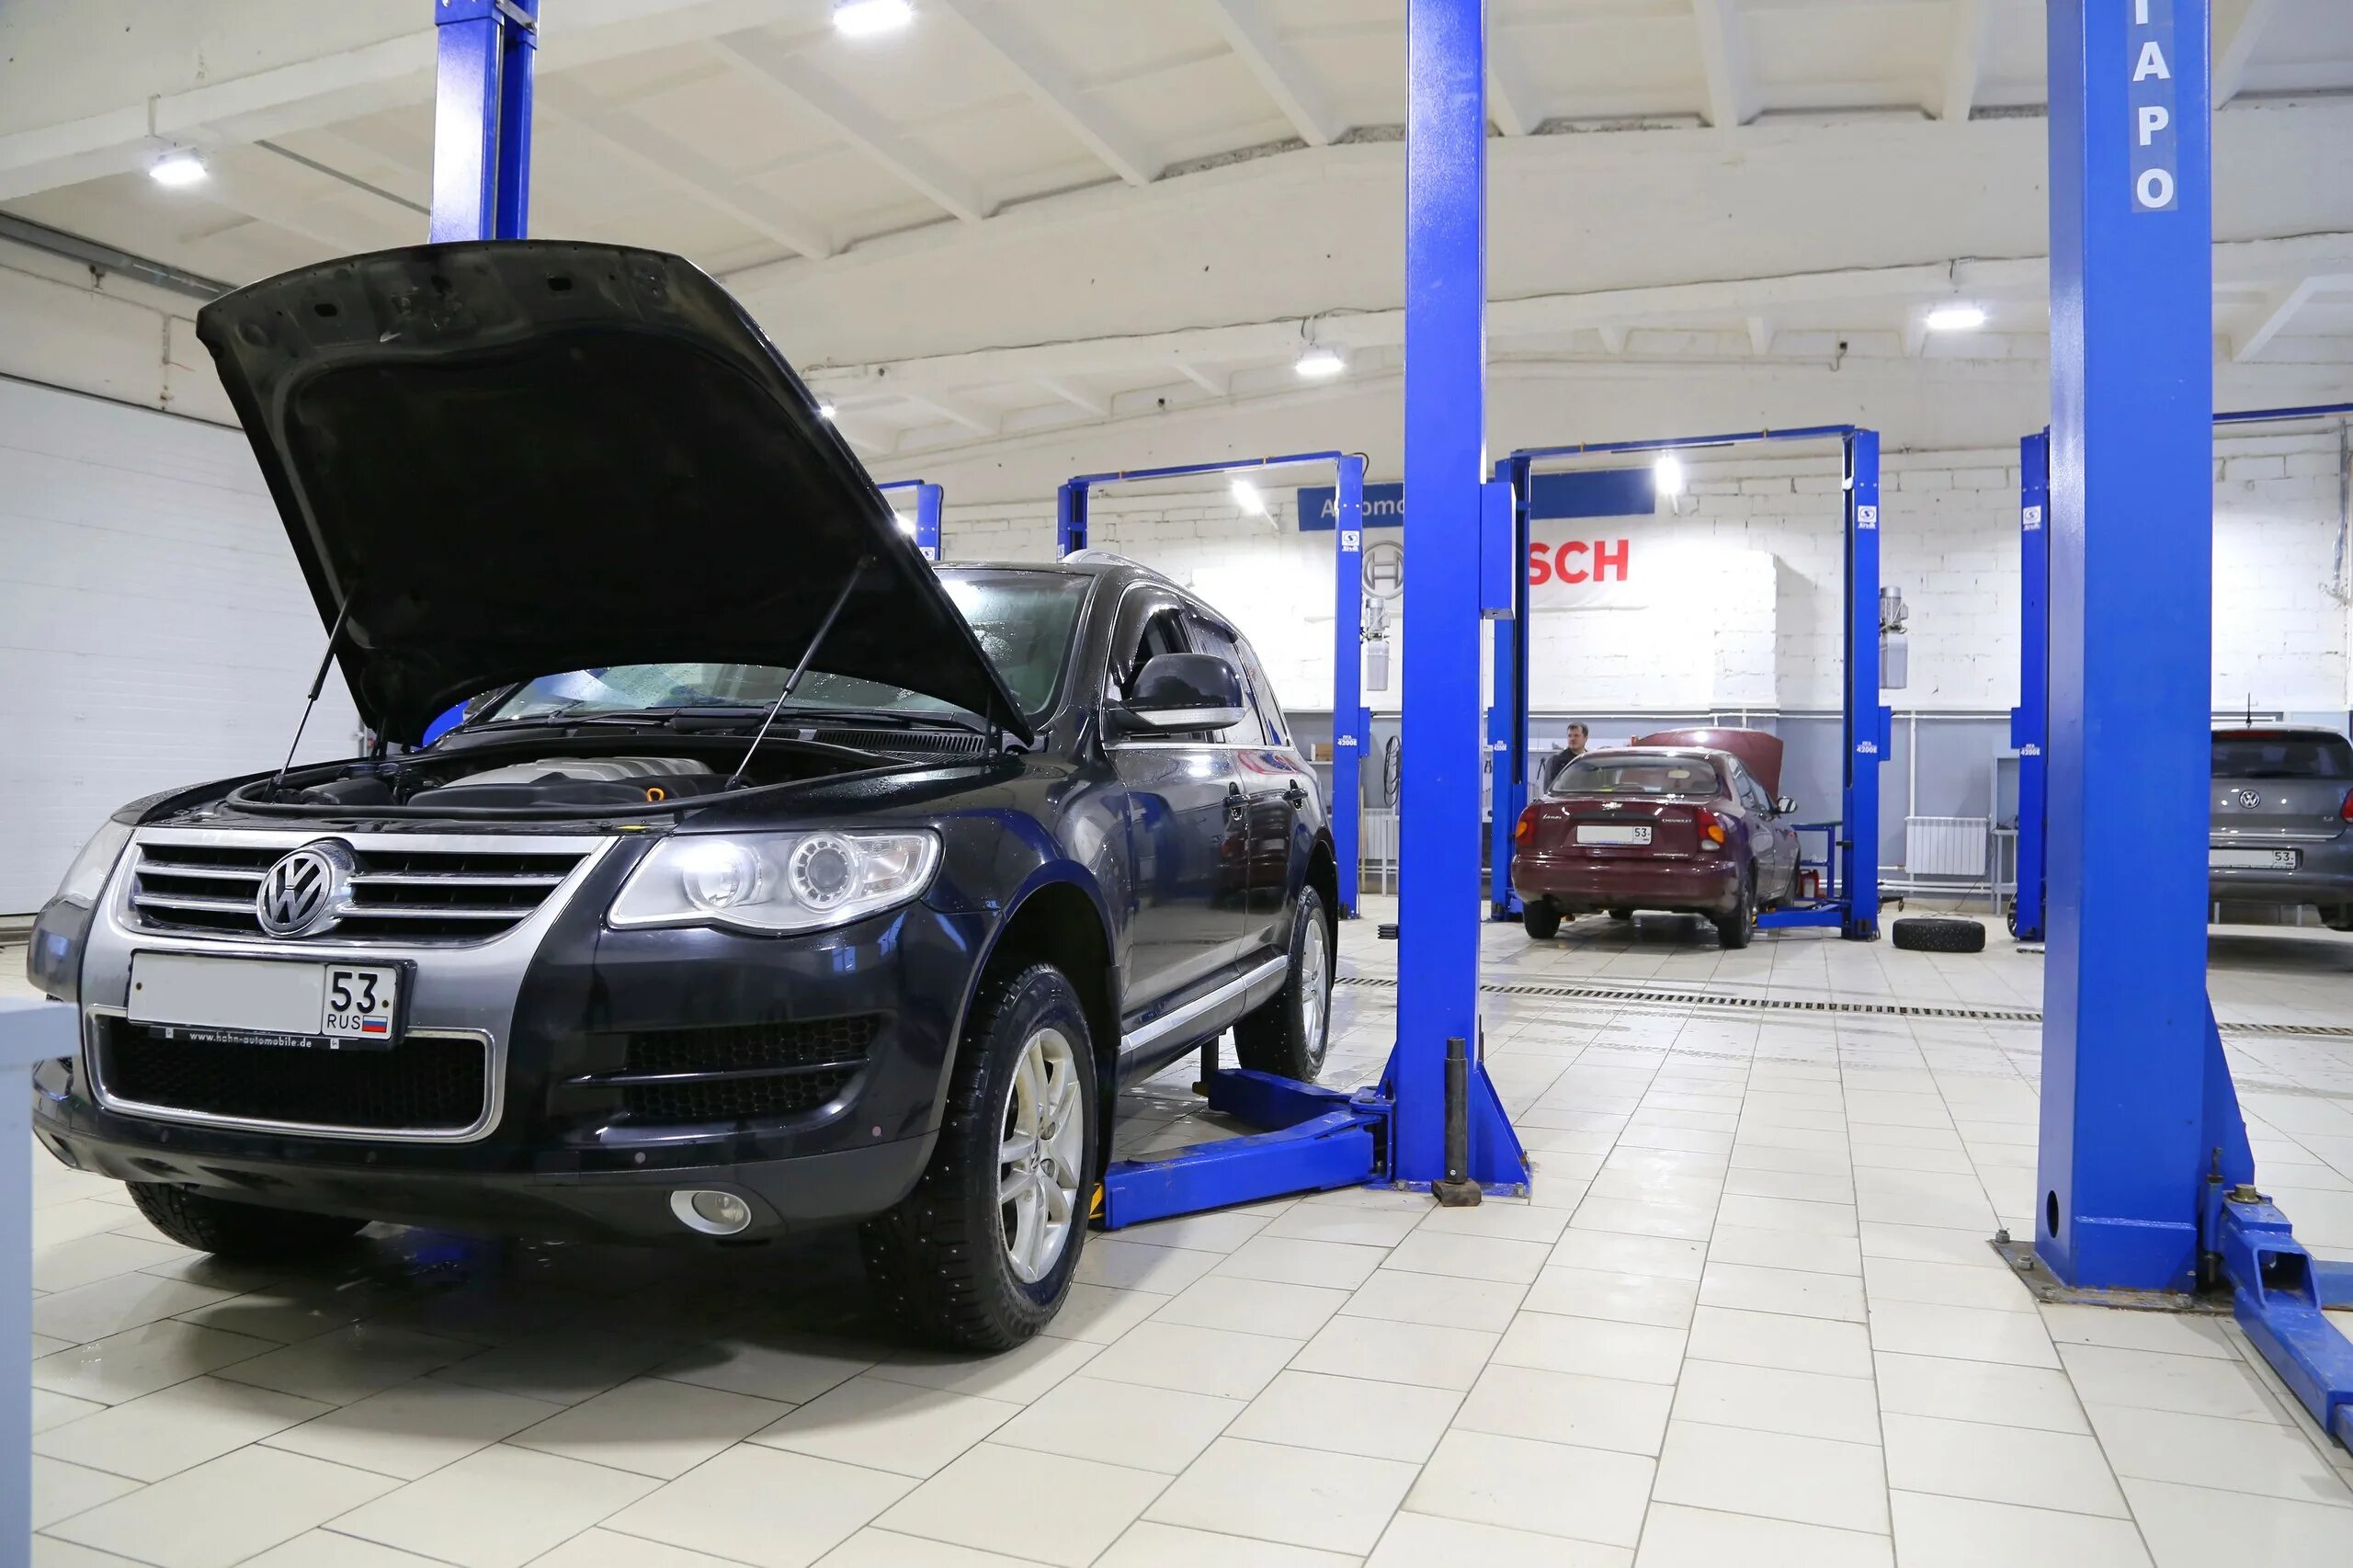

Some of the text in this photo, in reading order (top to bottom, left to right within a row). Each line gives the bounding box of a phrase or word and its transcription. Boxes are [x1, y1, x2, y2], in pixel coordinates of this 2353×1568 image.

[1529, 539, 1629, 585] SCH
[1634, 827, 1647, 837] 53
[2275, 852, 2290, 861] 53
[261, 851, 328, 930] VW
[331, 971, 378, 1014] 53
[326, 1013, 360, 1030] RUS
[189, 1031, 312, 1048] www.hahn-automobile.de
